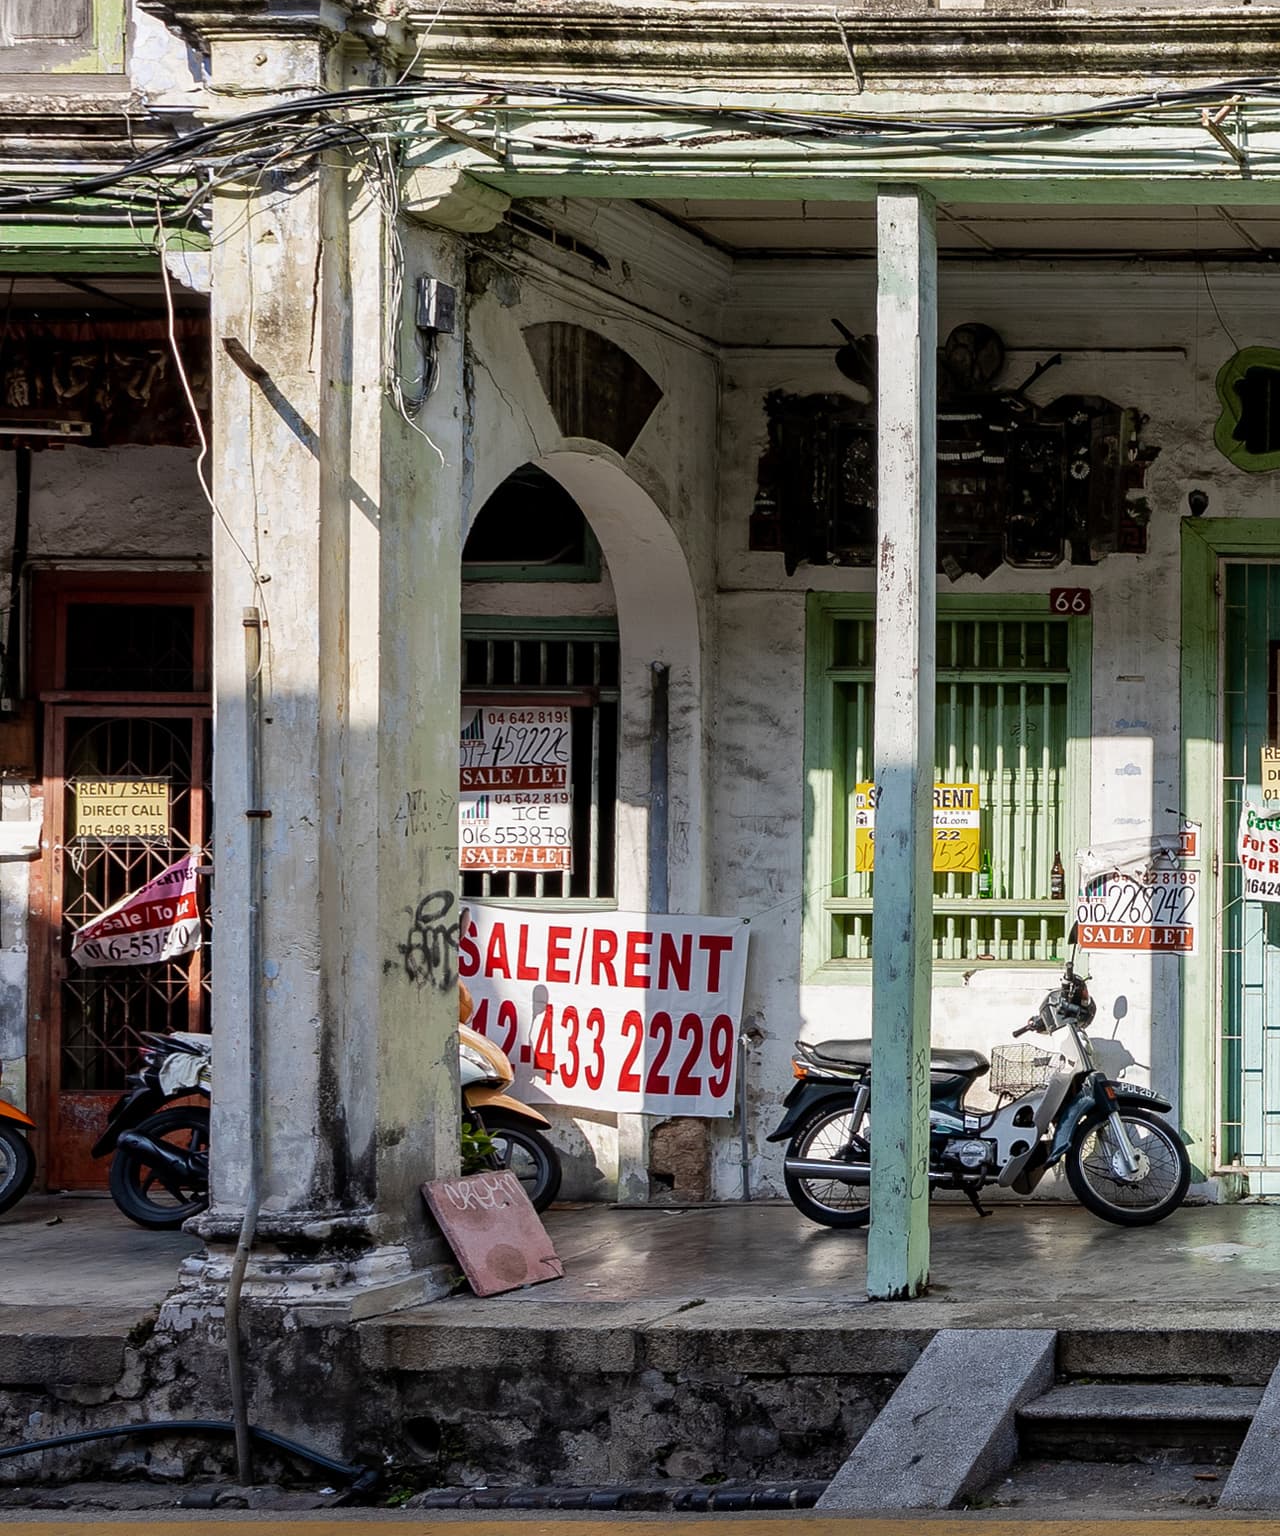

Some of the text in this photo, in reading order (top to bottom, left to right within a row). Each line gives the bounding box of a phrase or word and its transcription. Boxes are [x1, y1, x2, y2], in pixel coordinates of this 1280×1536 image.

[1055, 591, 1086, 612] 66
[488, 712, 505, 725] 04
[510, 712, 535, 724] 642
[462, 767, 567, 786] SALE / LET
[80, 782, 117, 796] RENT
[131, 782, 165, 796] SALE
[494, 792, 573, 805] 04 642 819
[82, 805, 163, 817] DIRECT CALL
[512, 806, 552, 821] ICE
[79, 824, 166, 836] 016-498 3158
[1242, 834, 1266, 853] For
[465, 847, 519, 865] SALE
[532, 847, 571, 865] LET
[1241, 854, 1266, 873] For
[1162, 872, 1197, 885] 8199
[152, 904, 174, 920] To
[1082, 926, 1190, 945] SALE / LET
[459, 920, 734, 993] SALE/RENT
[617, 1009, 735, 1099] 2229
